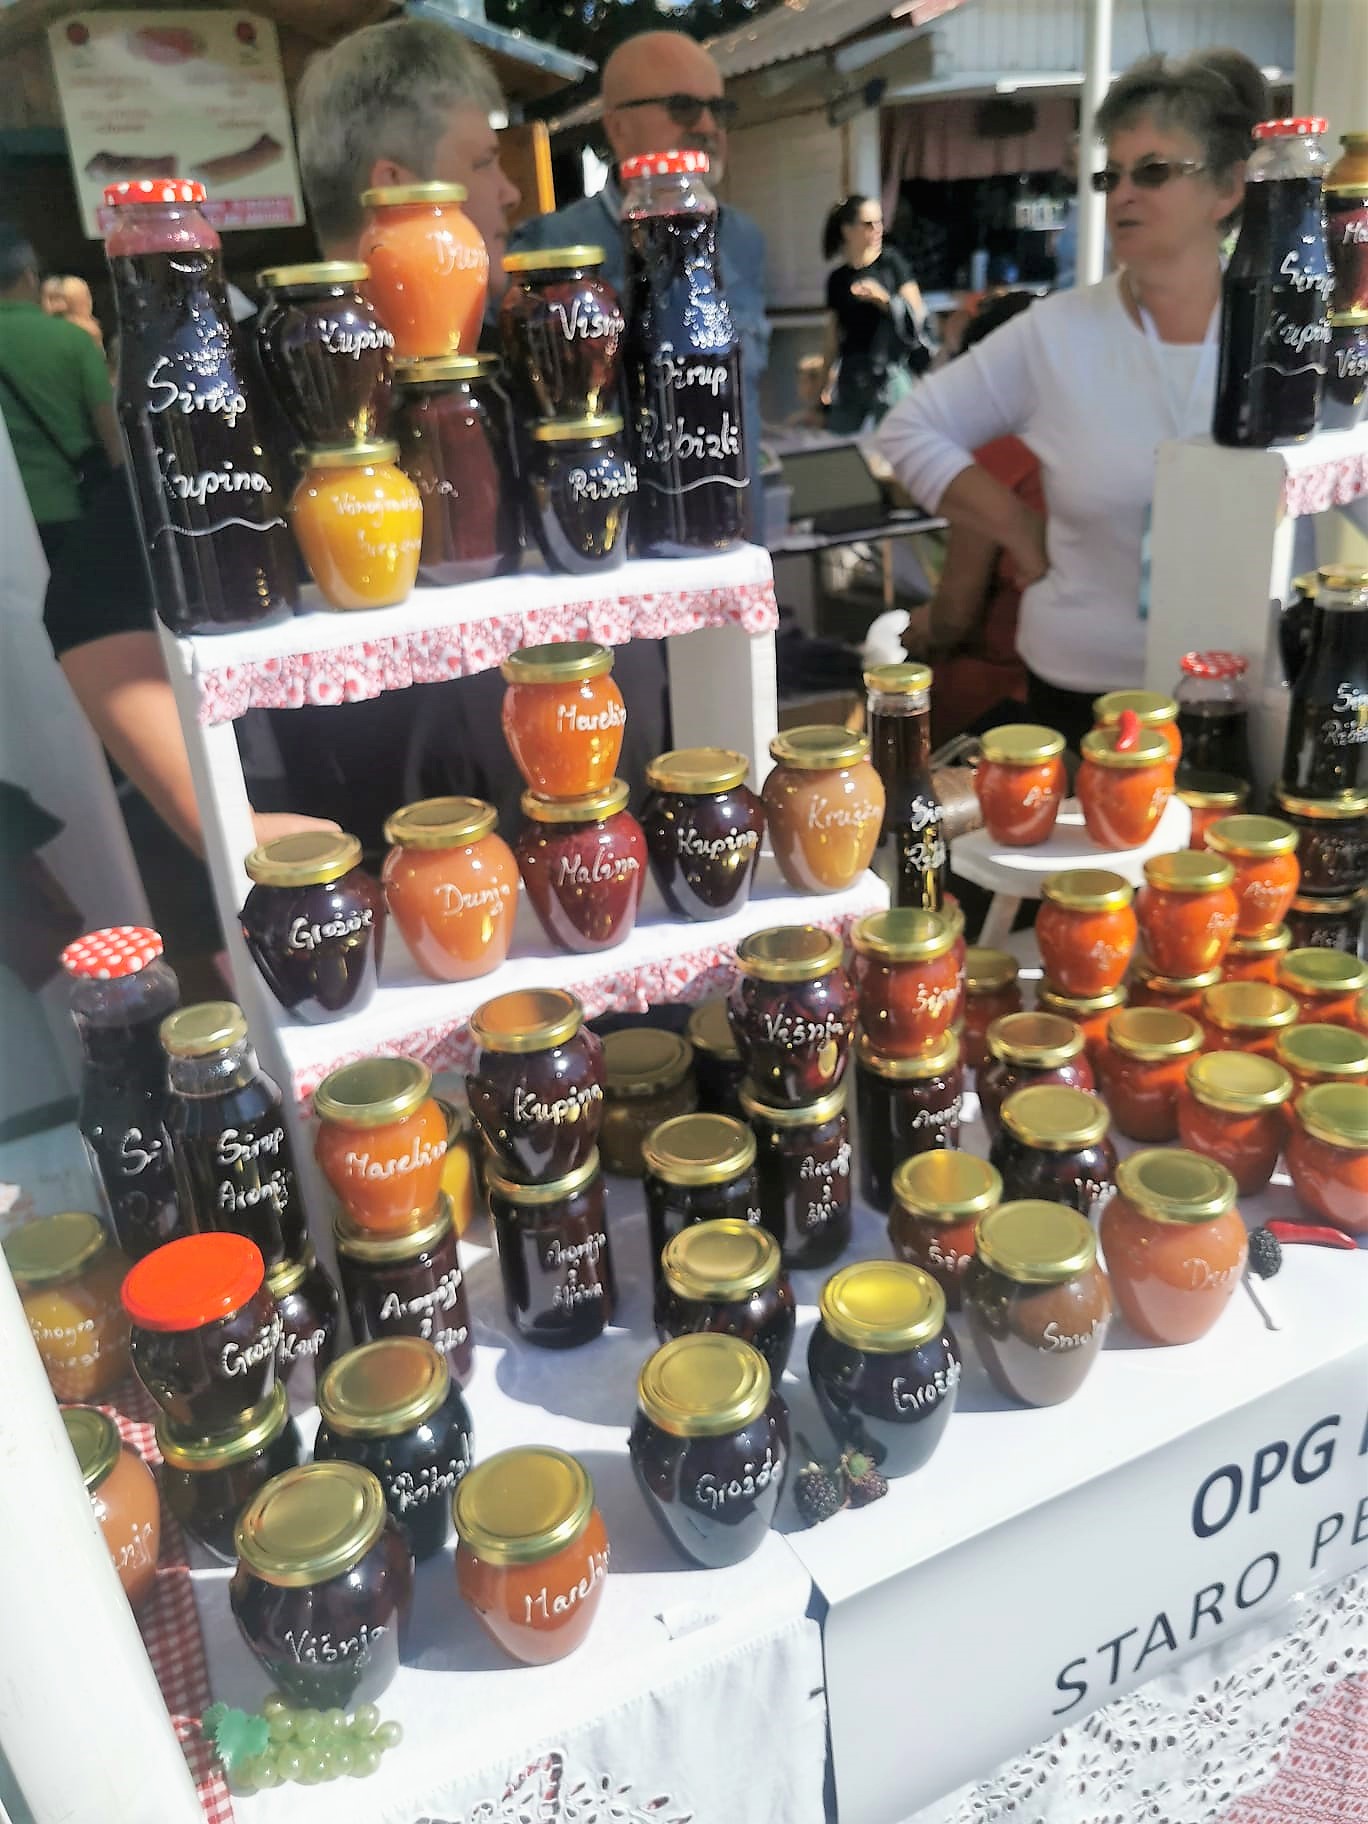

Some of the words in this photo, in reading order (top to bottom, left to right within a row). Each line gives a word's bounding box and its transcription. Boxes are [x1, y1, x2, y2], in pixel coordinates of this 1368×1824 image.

[147, 355, 247, 428] Sirup
[655, 341, 728, 397] Sirup
[558, 848, 641, 888] Malina
[218, 1128, 284, 1164] Sirup
[1191, 1414, 1342, 1538] OPG
[1052, 1551, 1281, 1716] STARO
